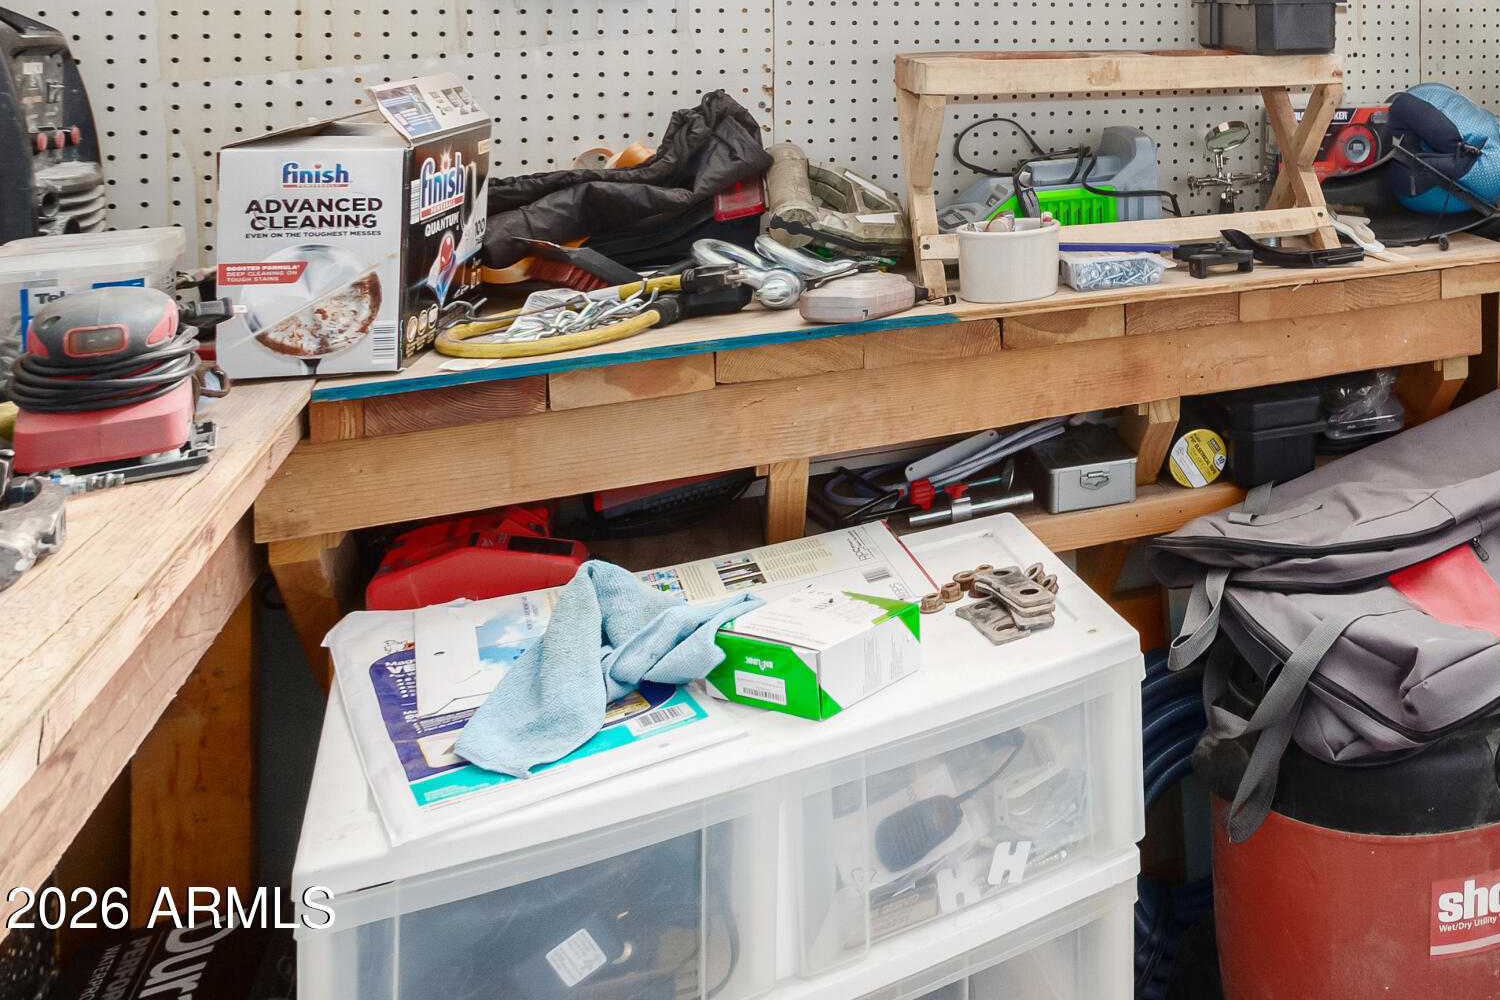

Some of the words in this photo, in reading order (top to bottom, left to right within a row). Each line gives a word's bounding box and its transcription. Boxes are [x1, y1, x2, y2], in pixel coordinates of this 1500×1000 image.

[282, 162, 350, 184] finish
[421, 151, 465, 210] finish
[245, 197, 383, 215] ADVANCED
[250, 213, 377, 232] CLEANING
[424, 212, 459, 238] QUANTUM
[1438, 920, 1473, 933] Wet/Dry
[1474, 915, 1497, 928] Utility
